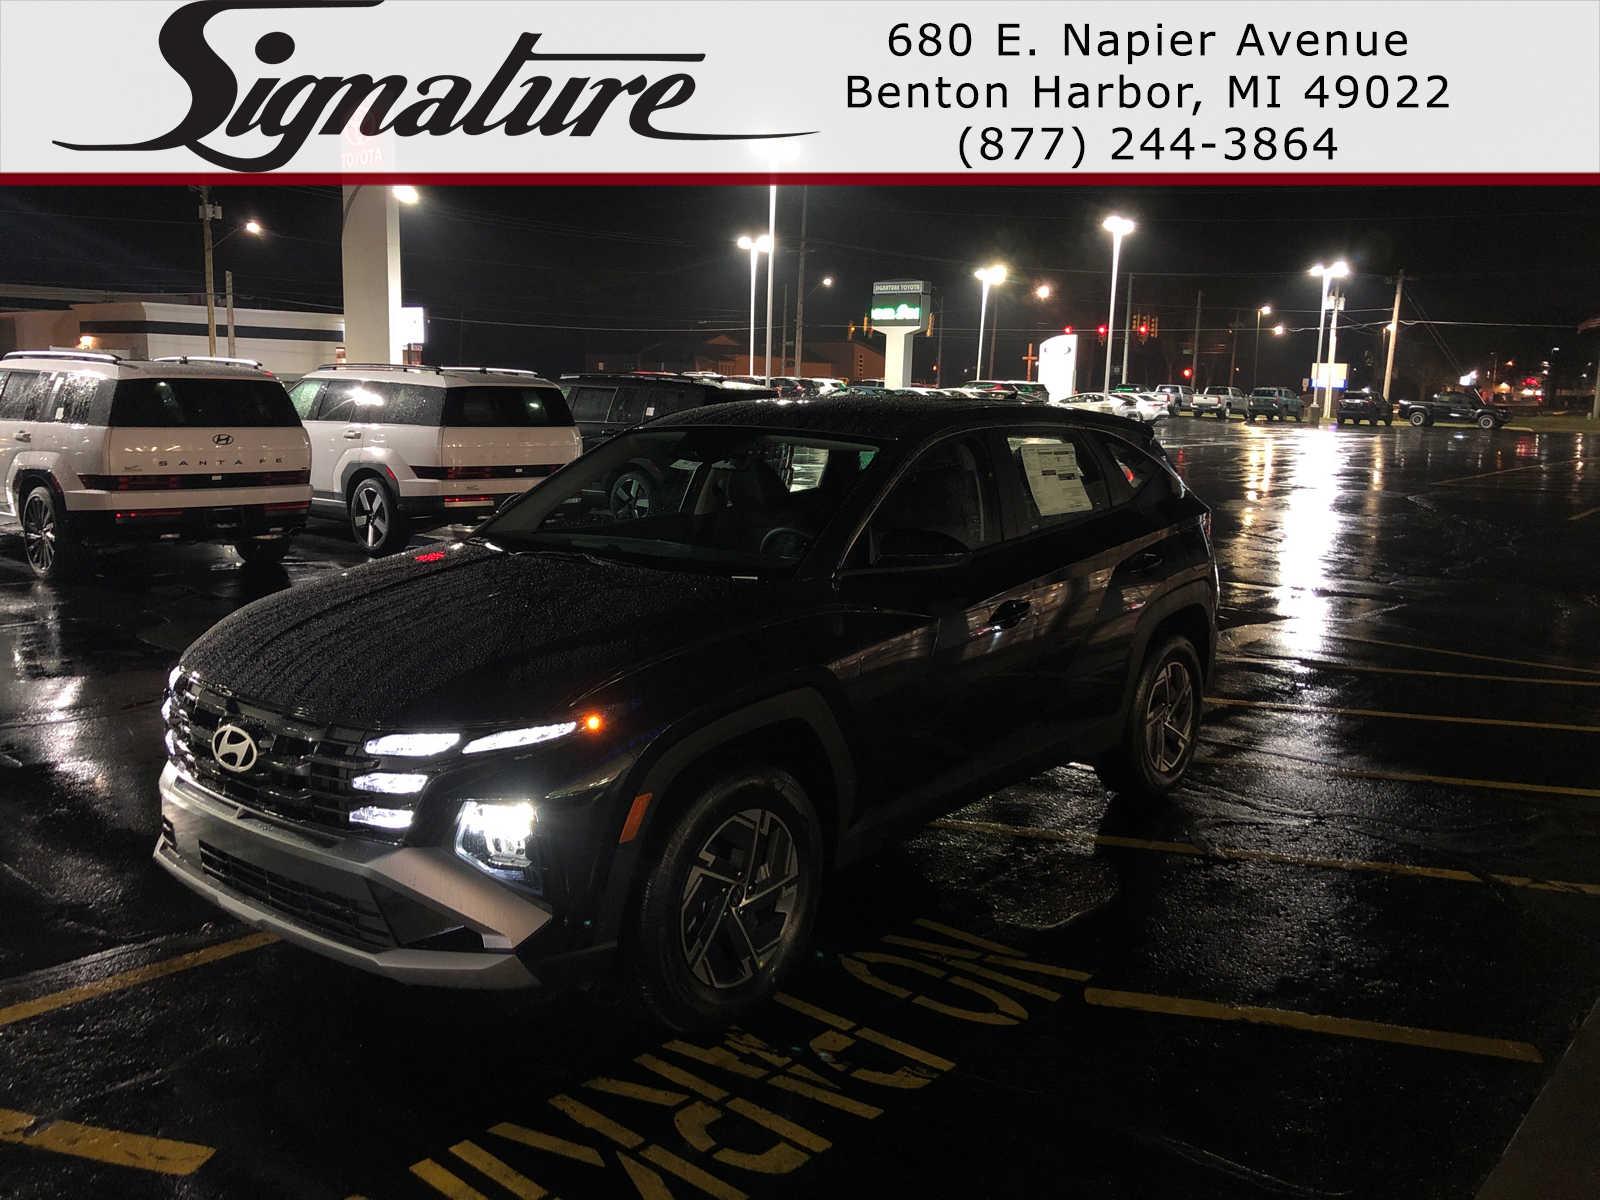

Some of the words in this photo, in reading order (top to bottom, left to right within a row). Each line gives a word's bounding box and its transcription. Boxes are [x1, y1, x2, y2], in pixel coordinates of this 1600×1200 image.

[158, 458, 243, 468] SANTA
[258, 457, 283, 465] FE
[837, 917, 1093, 1026] NO
